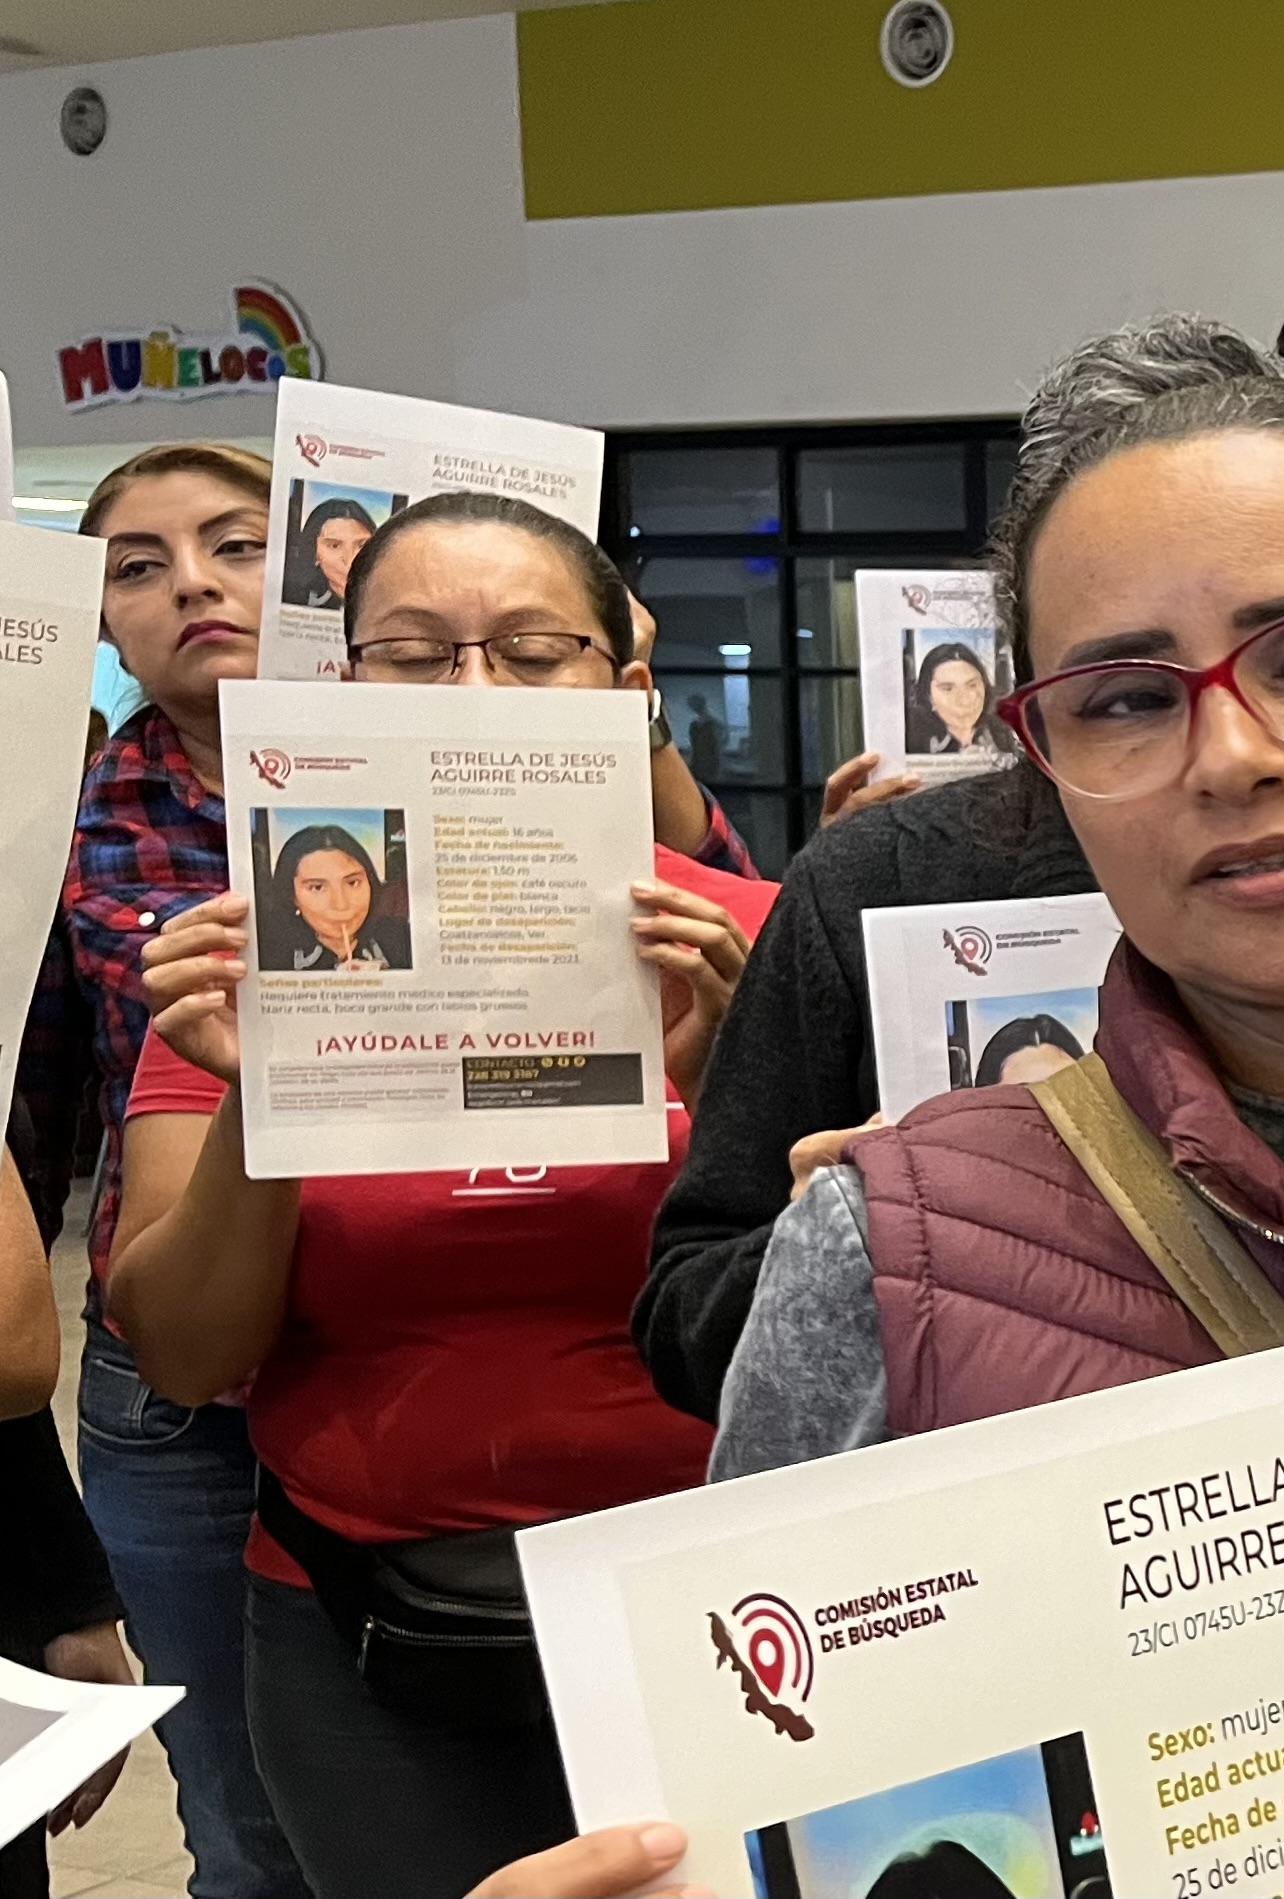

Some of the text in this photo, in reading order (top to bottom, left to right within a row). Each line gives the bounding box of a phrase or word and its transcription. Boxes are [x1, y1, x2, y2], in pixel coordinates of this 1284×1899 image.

[59, 331, 310, 405] MUÑELOCOS
[0, 617, 58, 643] ESÚS
[430, 750, 617, 768] ESTRELLA DE JESÚS
[430, 768, 607, 785] AGUIRRE ROSALES
[317, 1030, 595, 1057] ¡AYÚDALE A VOLVER!
[814, 1568, 979, 1627] COMISIÓN ESTATAL
[819, 1603, 947, 1654] DE BÚSQUEDA
[1127, 1621, 1179, 1657] 23/CI
[1147, 1722, 1216, 1762] Sexo:
[1156, 1761, 1222, 1809] Edad
[1165, 1811, 1241, 1856] Fecha
[1246, 1797, 1277, 1828] de
[1172, 1867, 1202, 1899] 25
[1207, 1858, 1238, 1890] de
